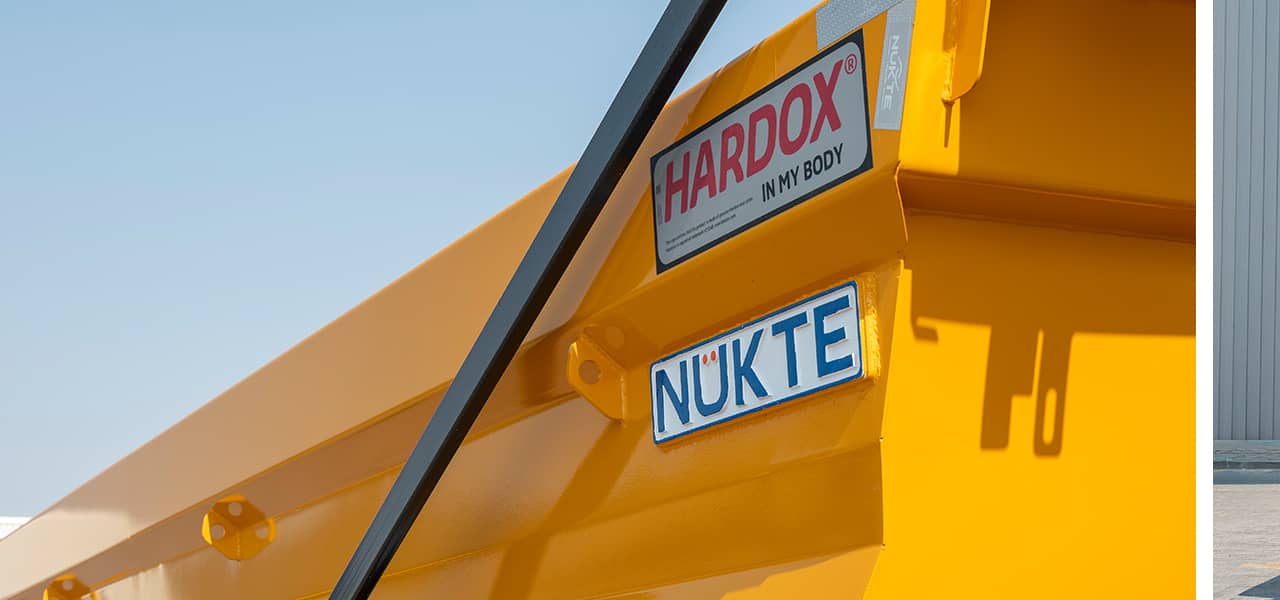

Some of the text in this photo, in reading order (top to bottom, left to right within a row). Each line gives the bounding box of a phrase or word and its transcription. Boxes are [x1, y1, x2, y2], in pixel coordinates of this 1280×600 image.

[762, 142, 843, 202] IN MY BODY
[655, 295, 854, 433] NÜKTE
